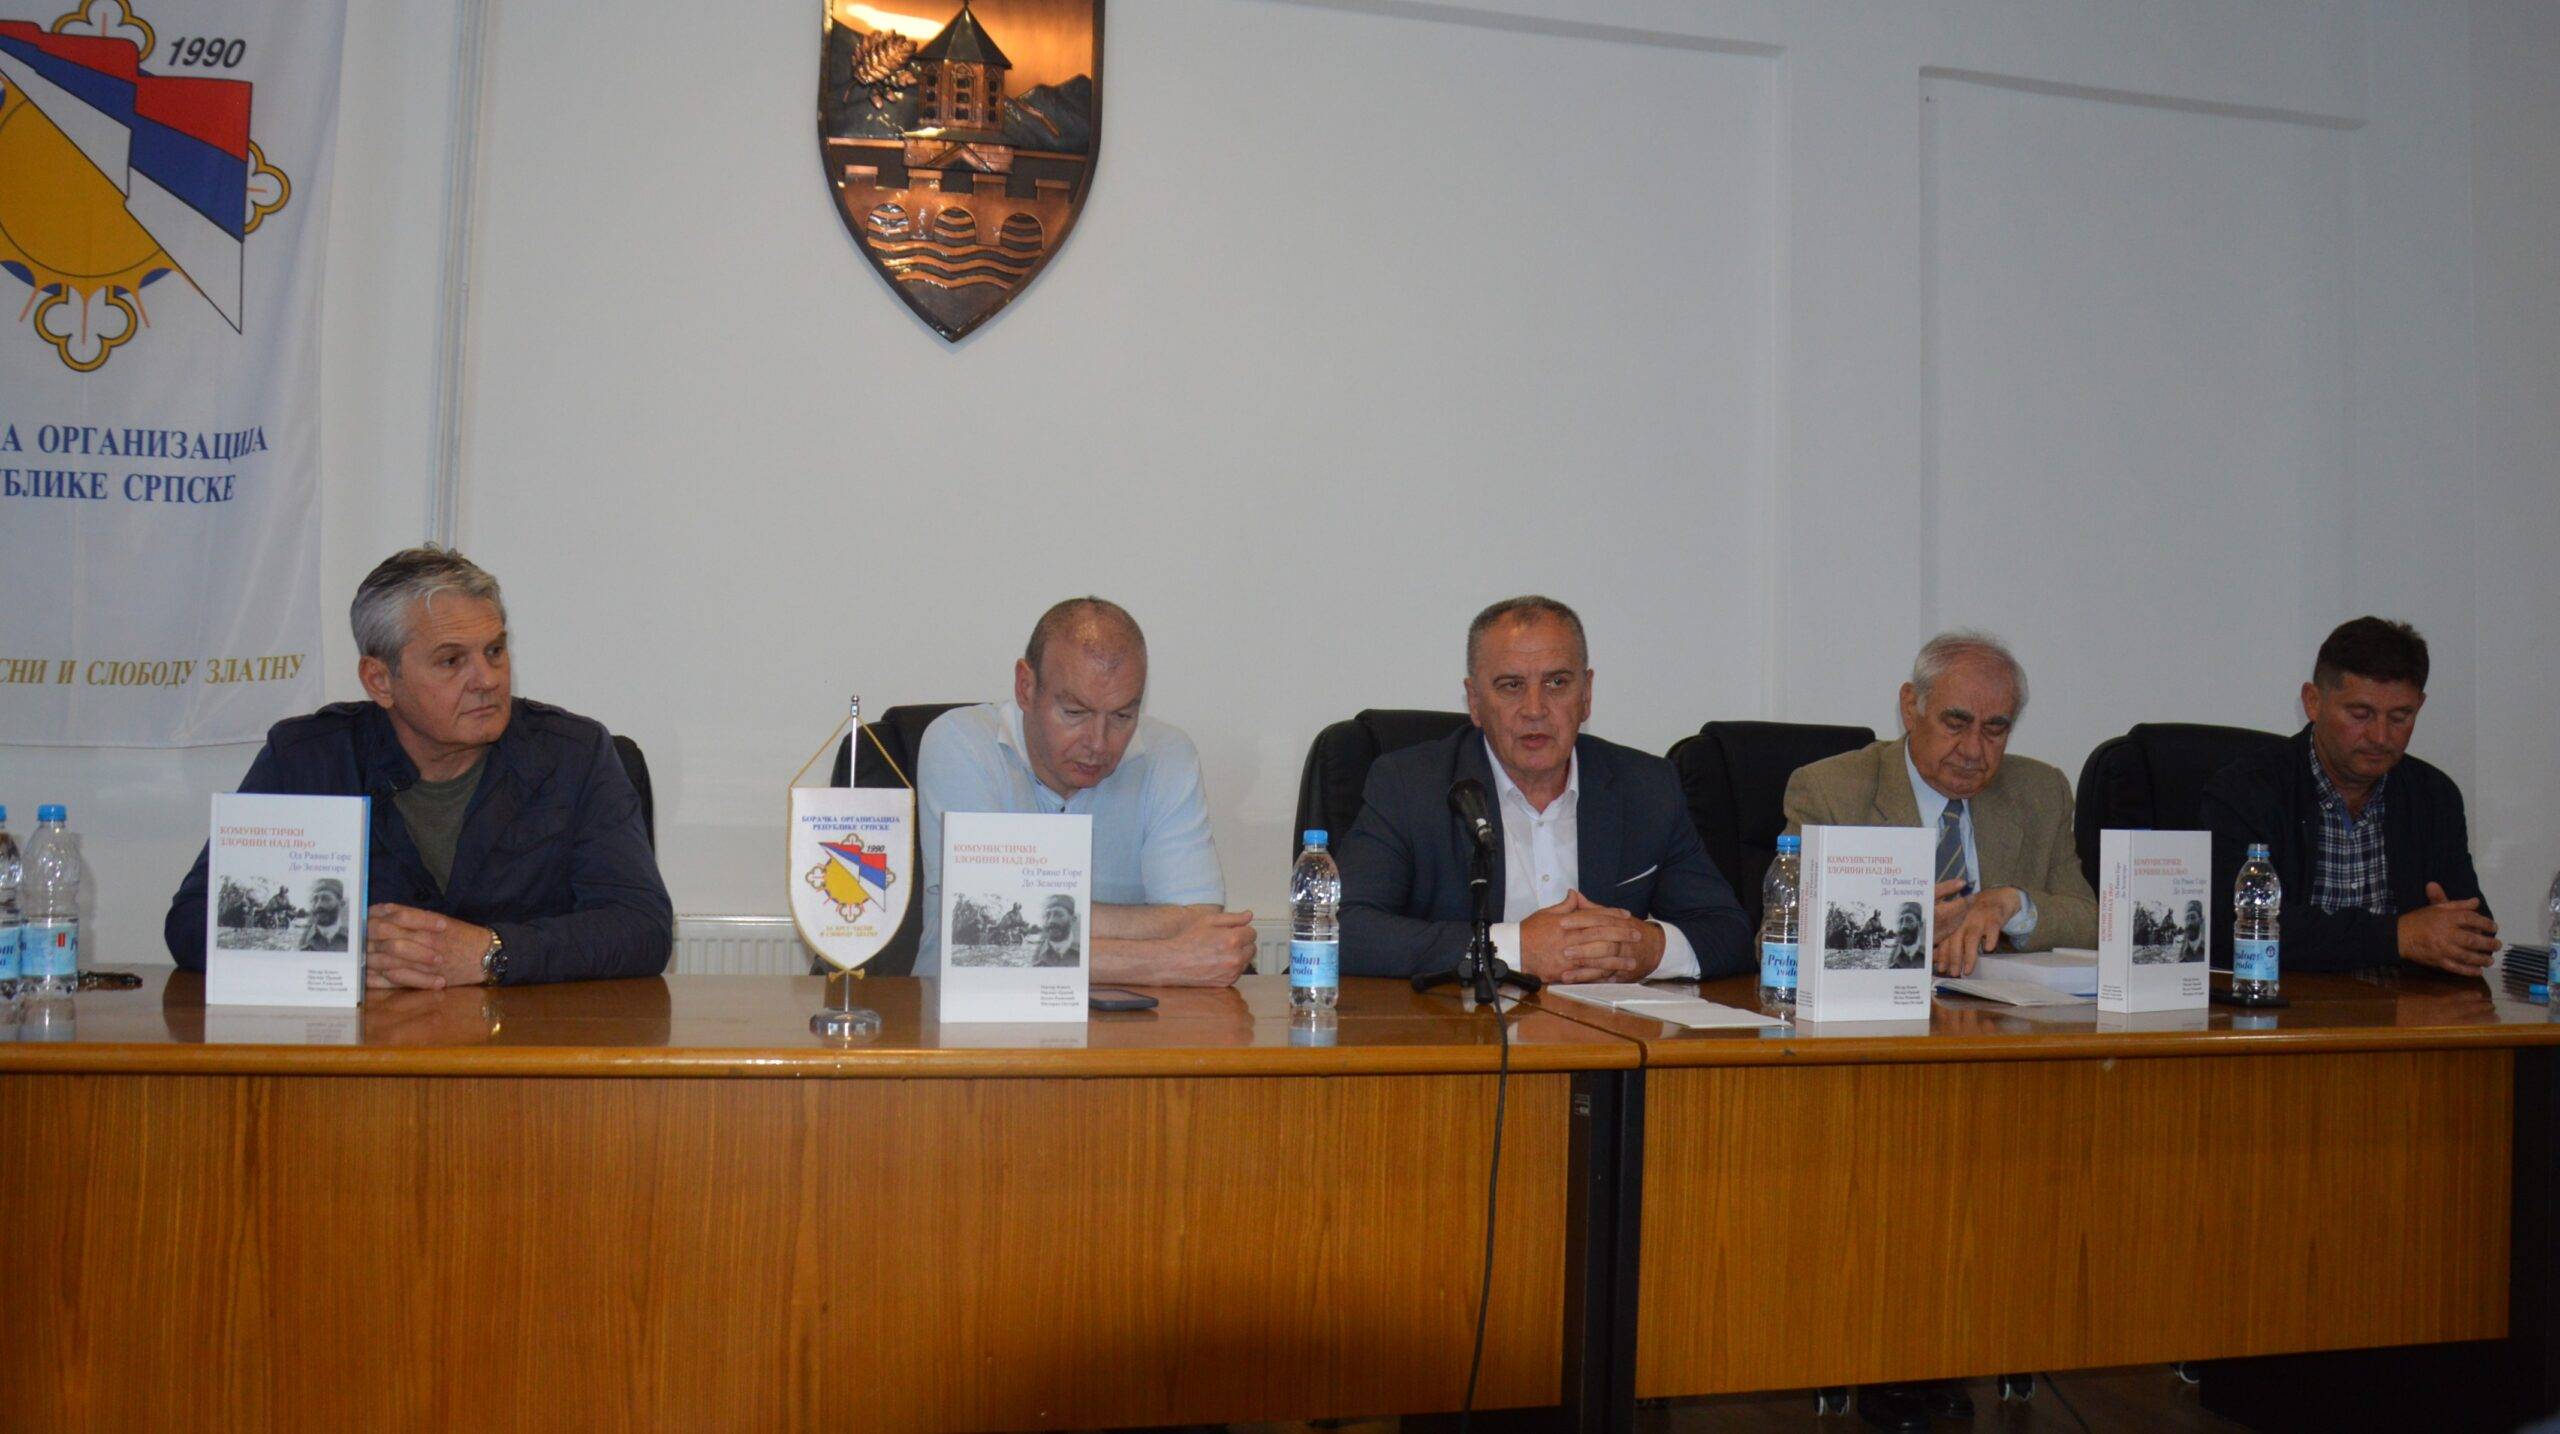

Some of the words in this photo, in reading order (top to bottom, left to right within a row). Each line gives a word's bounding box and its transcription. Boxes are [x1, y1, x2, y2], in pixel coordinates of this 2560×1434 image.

[168, 37, 247, 68] 1990
[38, 424, 271, 462] ОРГАНИЗАЦИЈА
[0, 468, 107, 500] БЛИКЕ
[124, 473, 237, 504] СРПСКЕ
[56, 659, 77, 685] И
[86, 660, 197, 688] СЛОБОДУ
[205, 654, 305, 684] ЗЛАТНУ
[802, 815, 837, 824] БОРАЧКА
[841, 816, 901, 824] ОРГАНИЗАЦИЈА
[866, 844, 885, 853] 1990
